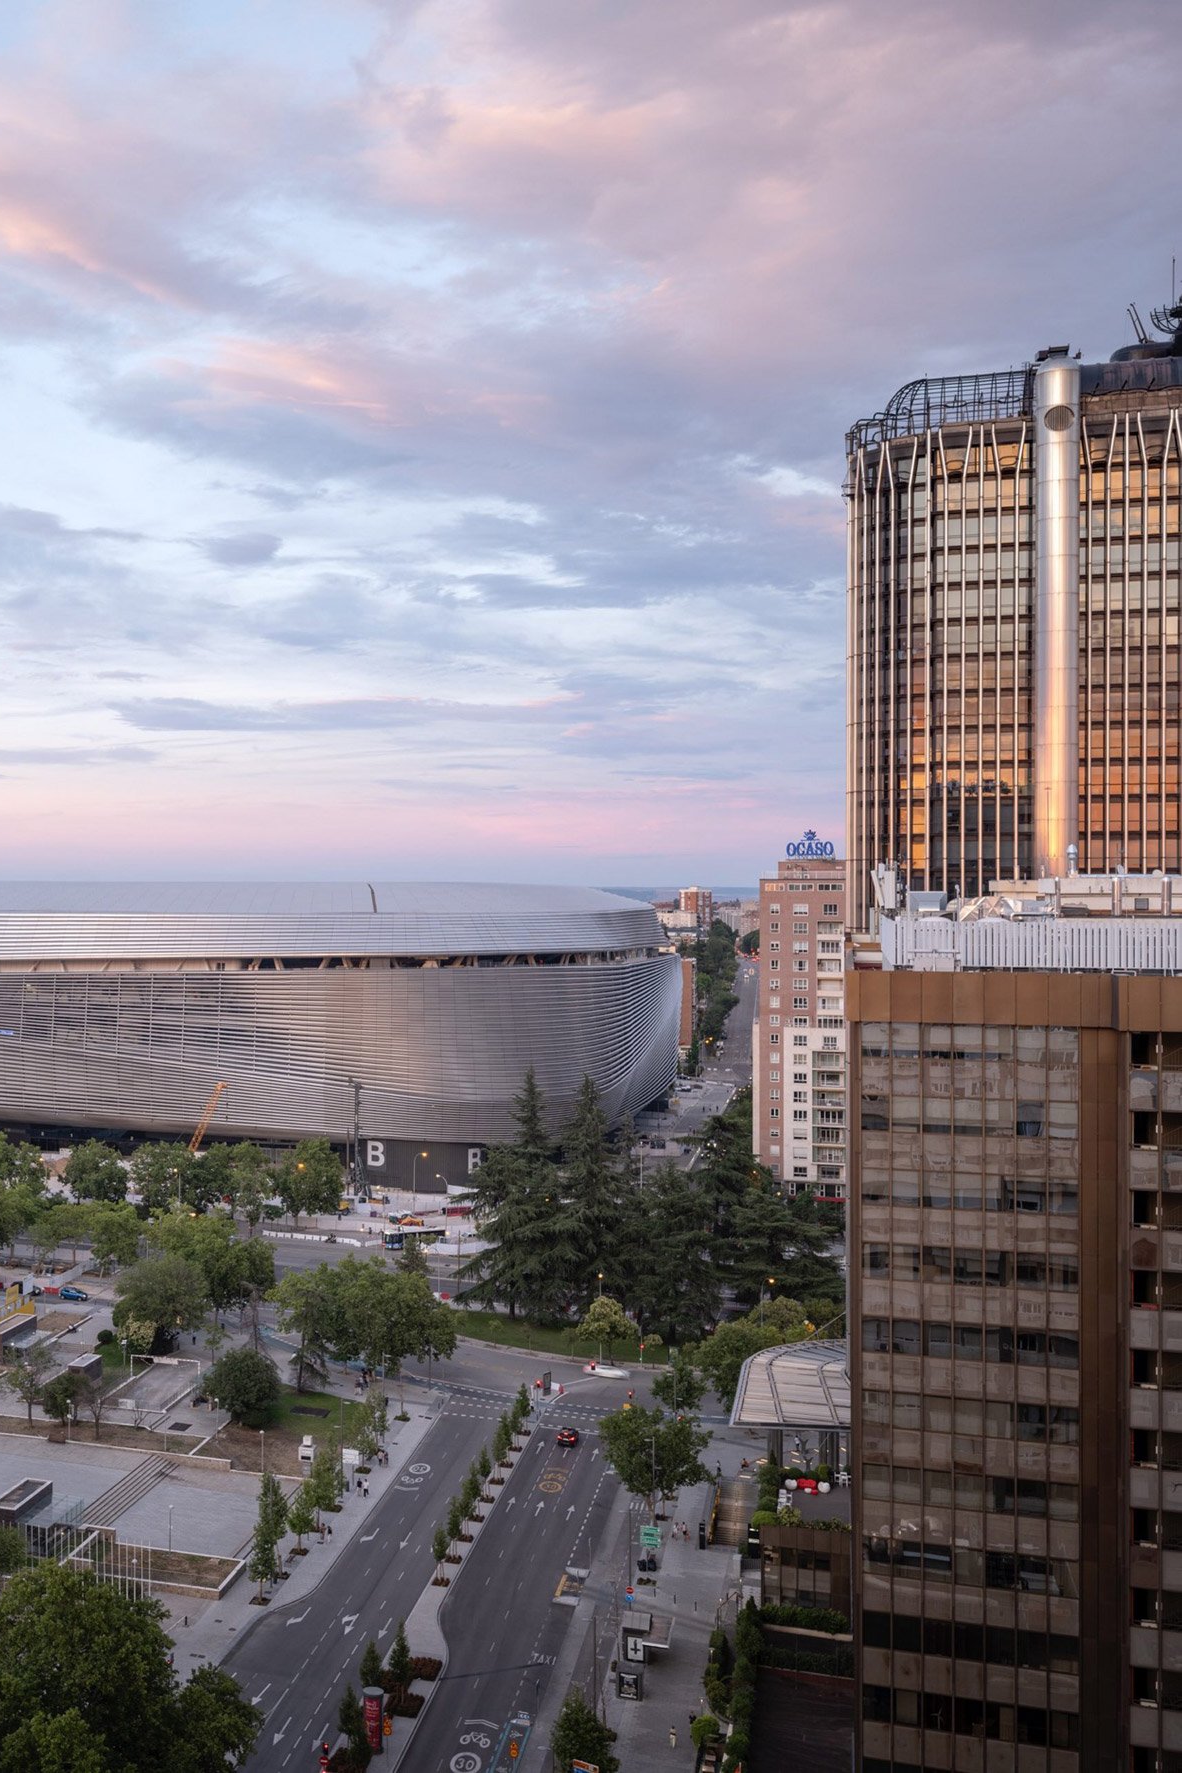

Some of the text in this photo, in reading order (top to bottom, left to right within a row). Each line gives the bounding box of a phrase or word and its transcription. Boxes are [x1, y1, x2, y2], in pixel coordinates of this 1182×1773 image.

[786, 841, 834, 857] OCASO
[367, 1140, 385, 1167] B
[533, 1653, 557, 1666] TAXI
[456, 1757, 475, 1771] 30
